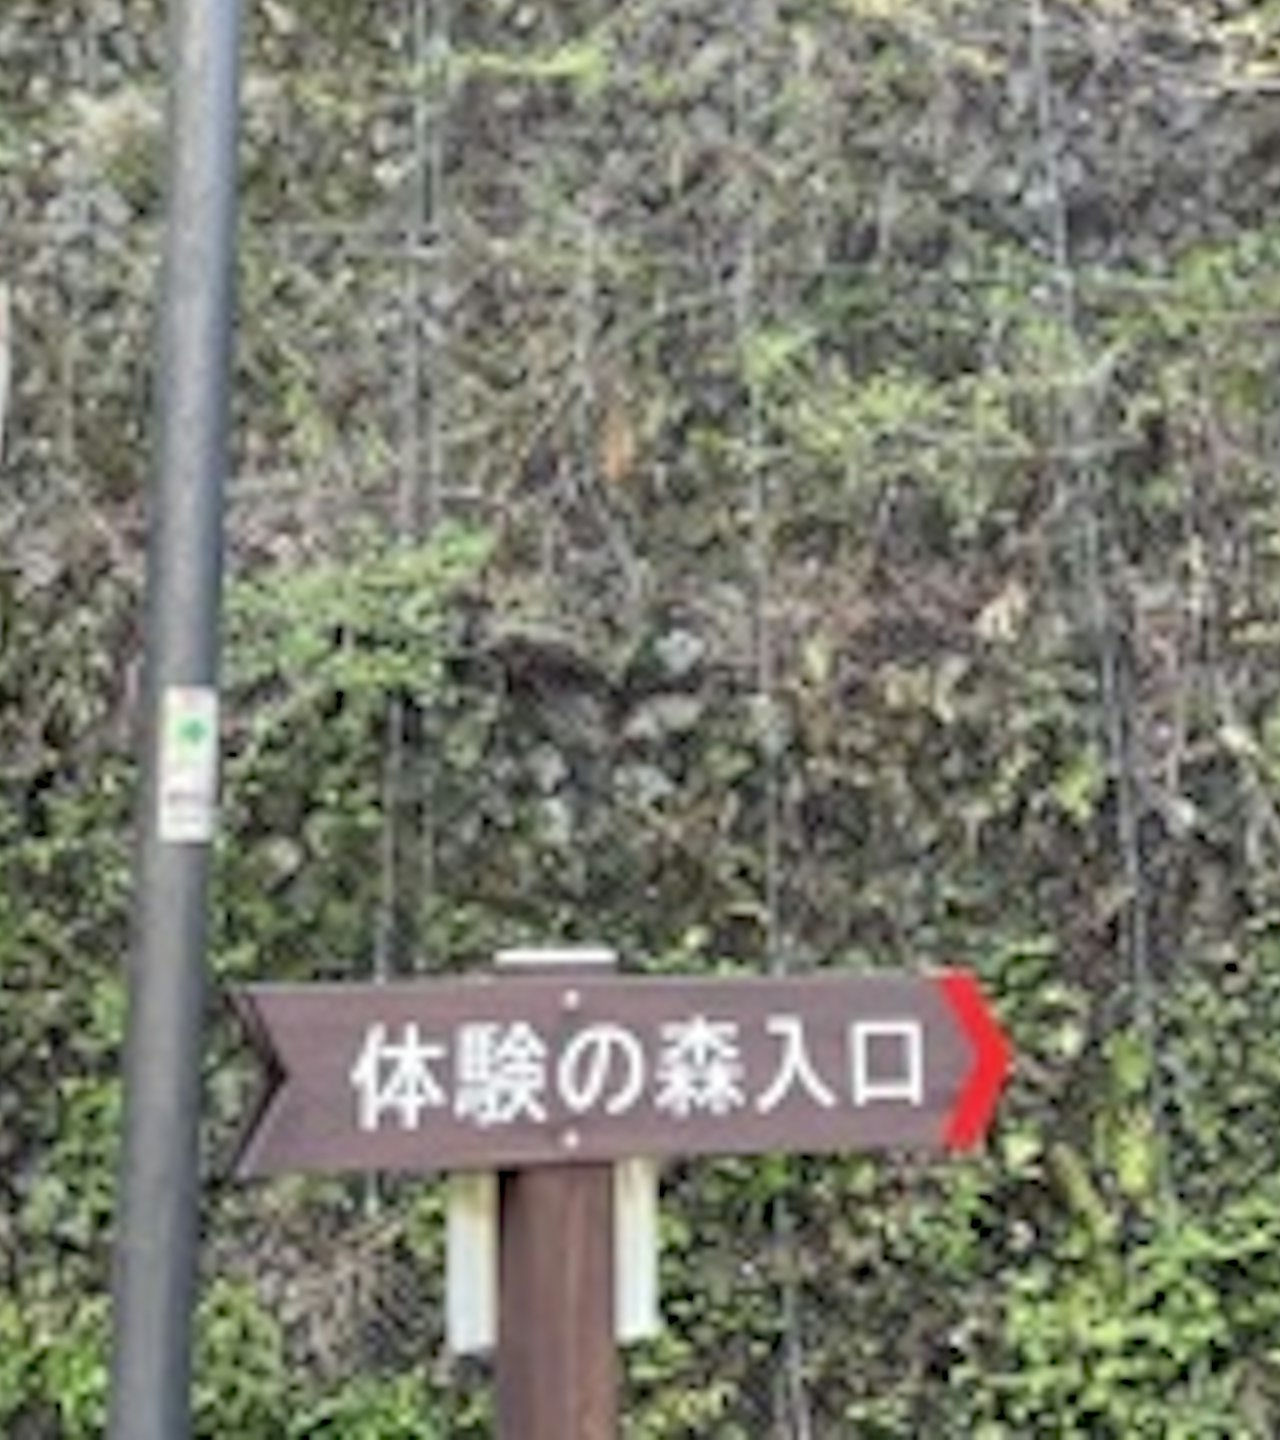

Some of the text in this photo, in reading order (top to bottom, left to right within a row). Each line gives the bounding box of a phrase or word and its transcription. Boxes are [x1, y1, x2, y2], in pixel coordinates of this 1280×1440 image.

[349, 1014, 923, 1131] 体験の森入口
